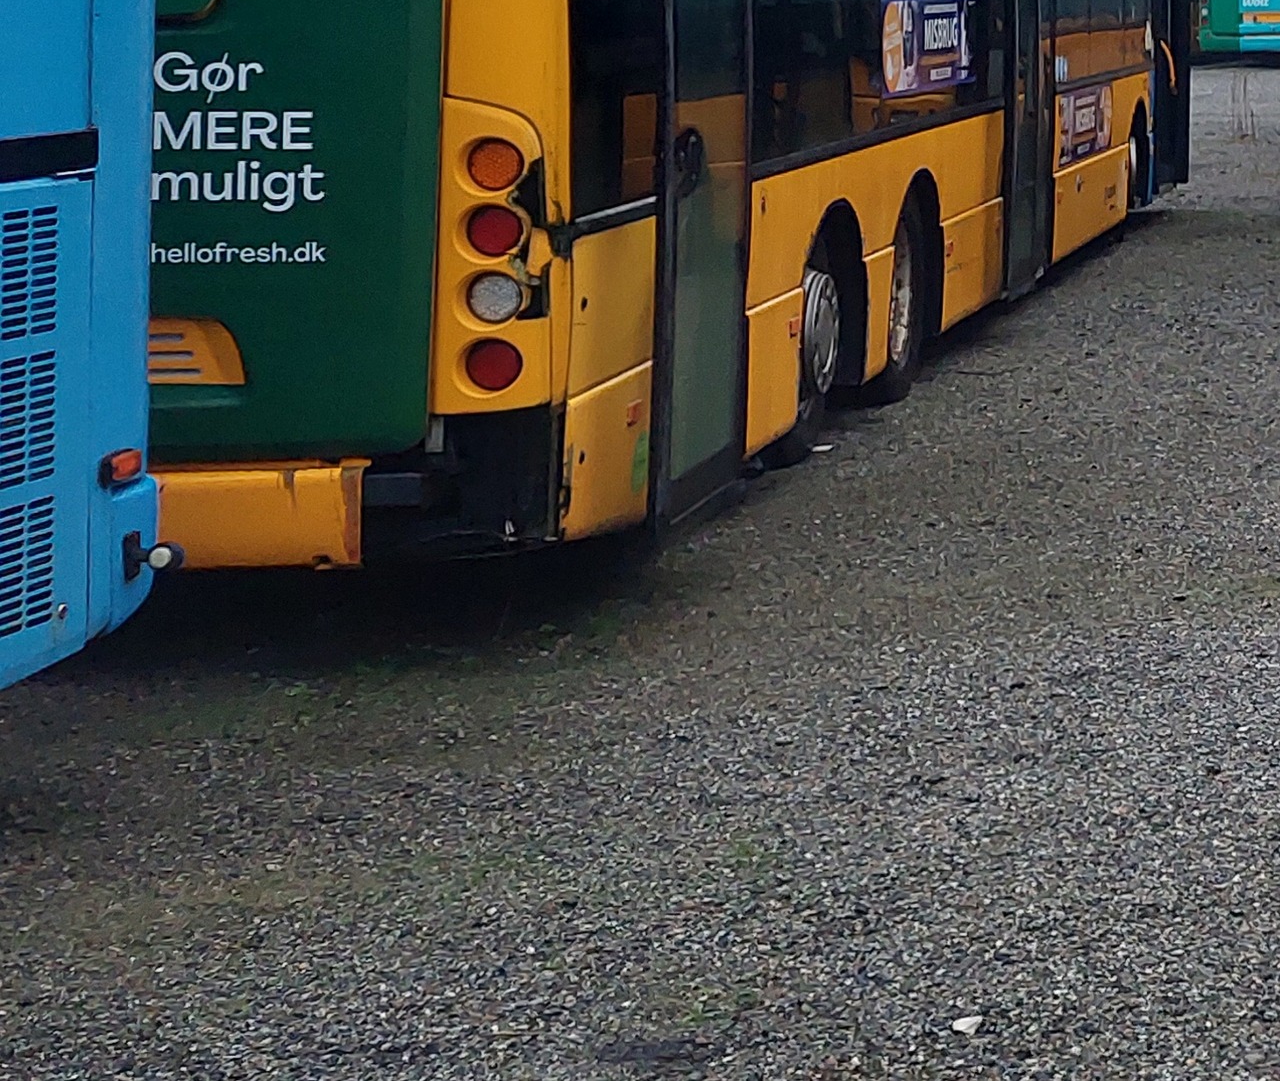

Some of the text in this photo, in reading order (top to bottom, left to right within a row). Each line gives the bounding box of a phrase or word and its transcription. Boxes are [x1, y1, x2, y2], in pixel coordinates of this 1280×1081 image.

[153, 51, 265, 104] Gør
[152, 111, 314, 150] MERE
[150, 160, 326, 213] muligt
[150, 241, 327, 264] hellofresh.dk
